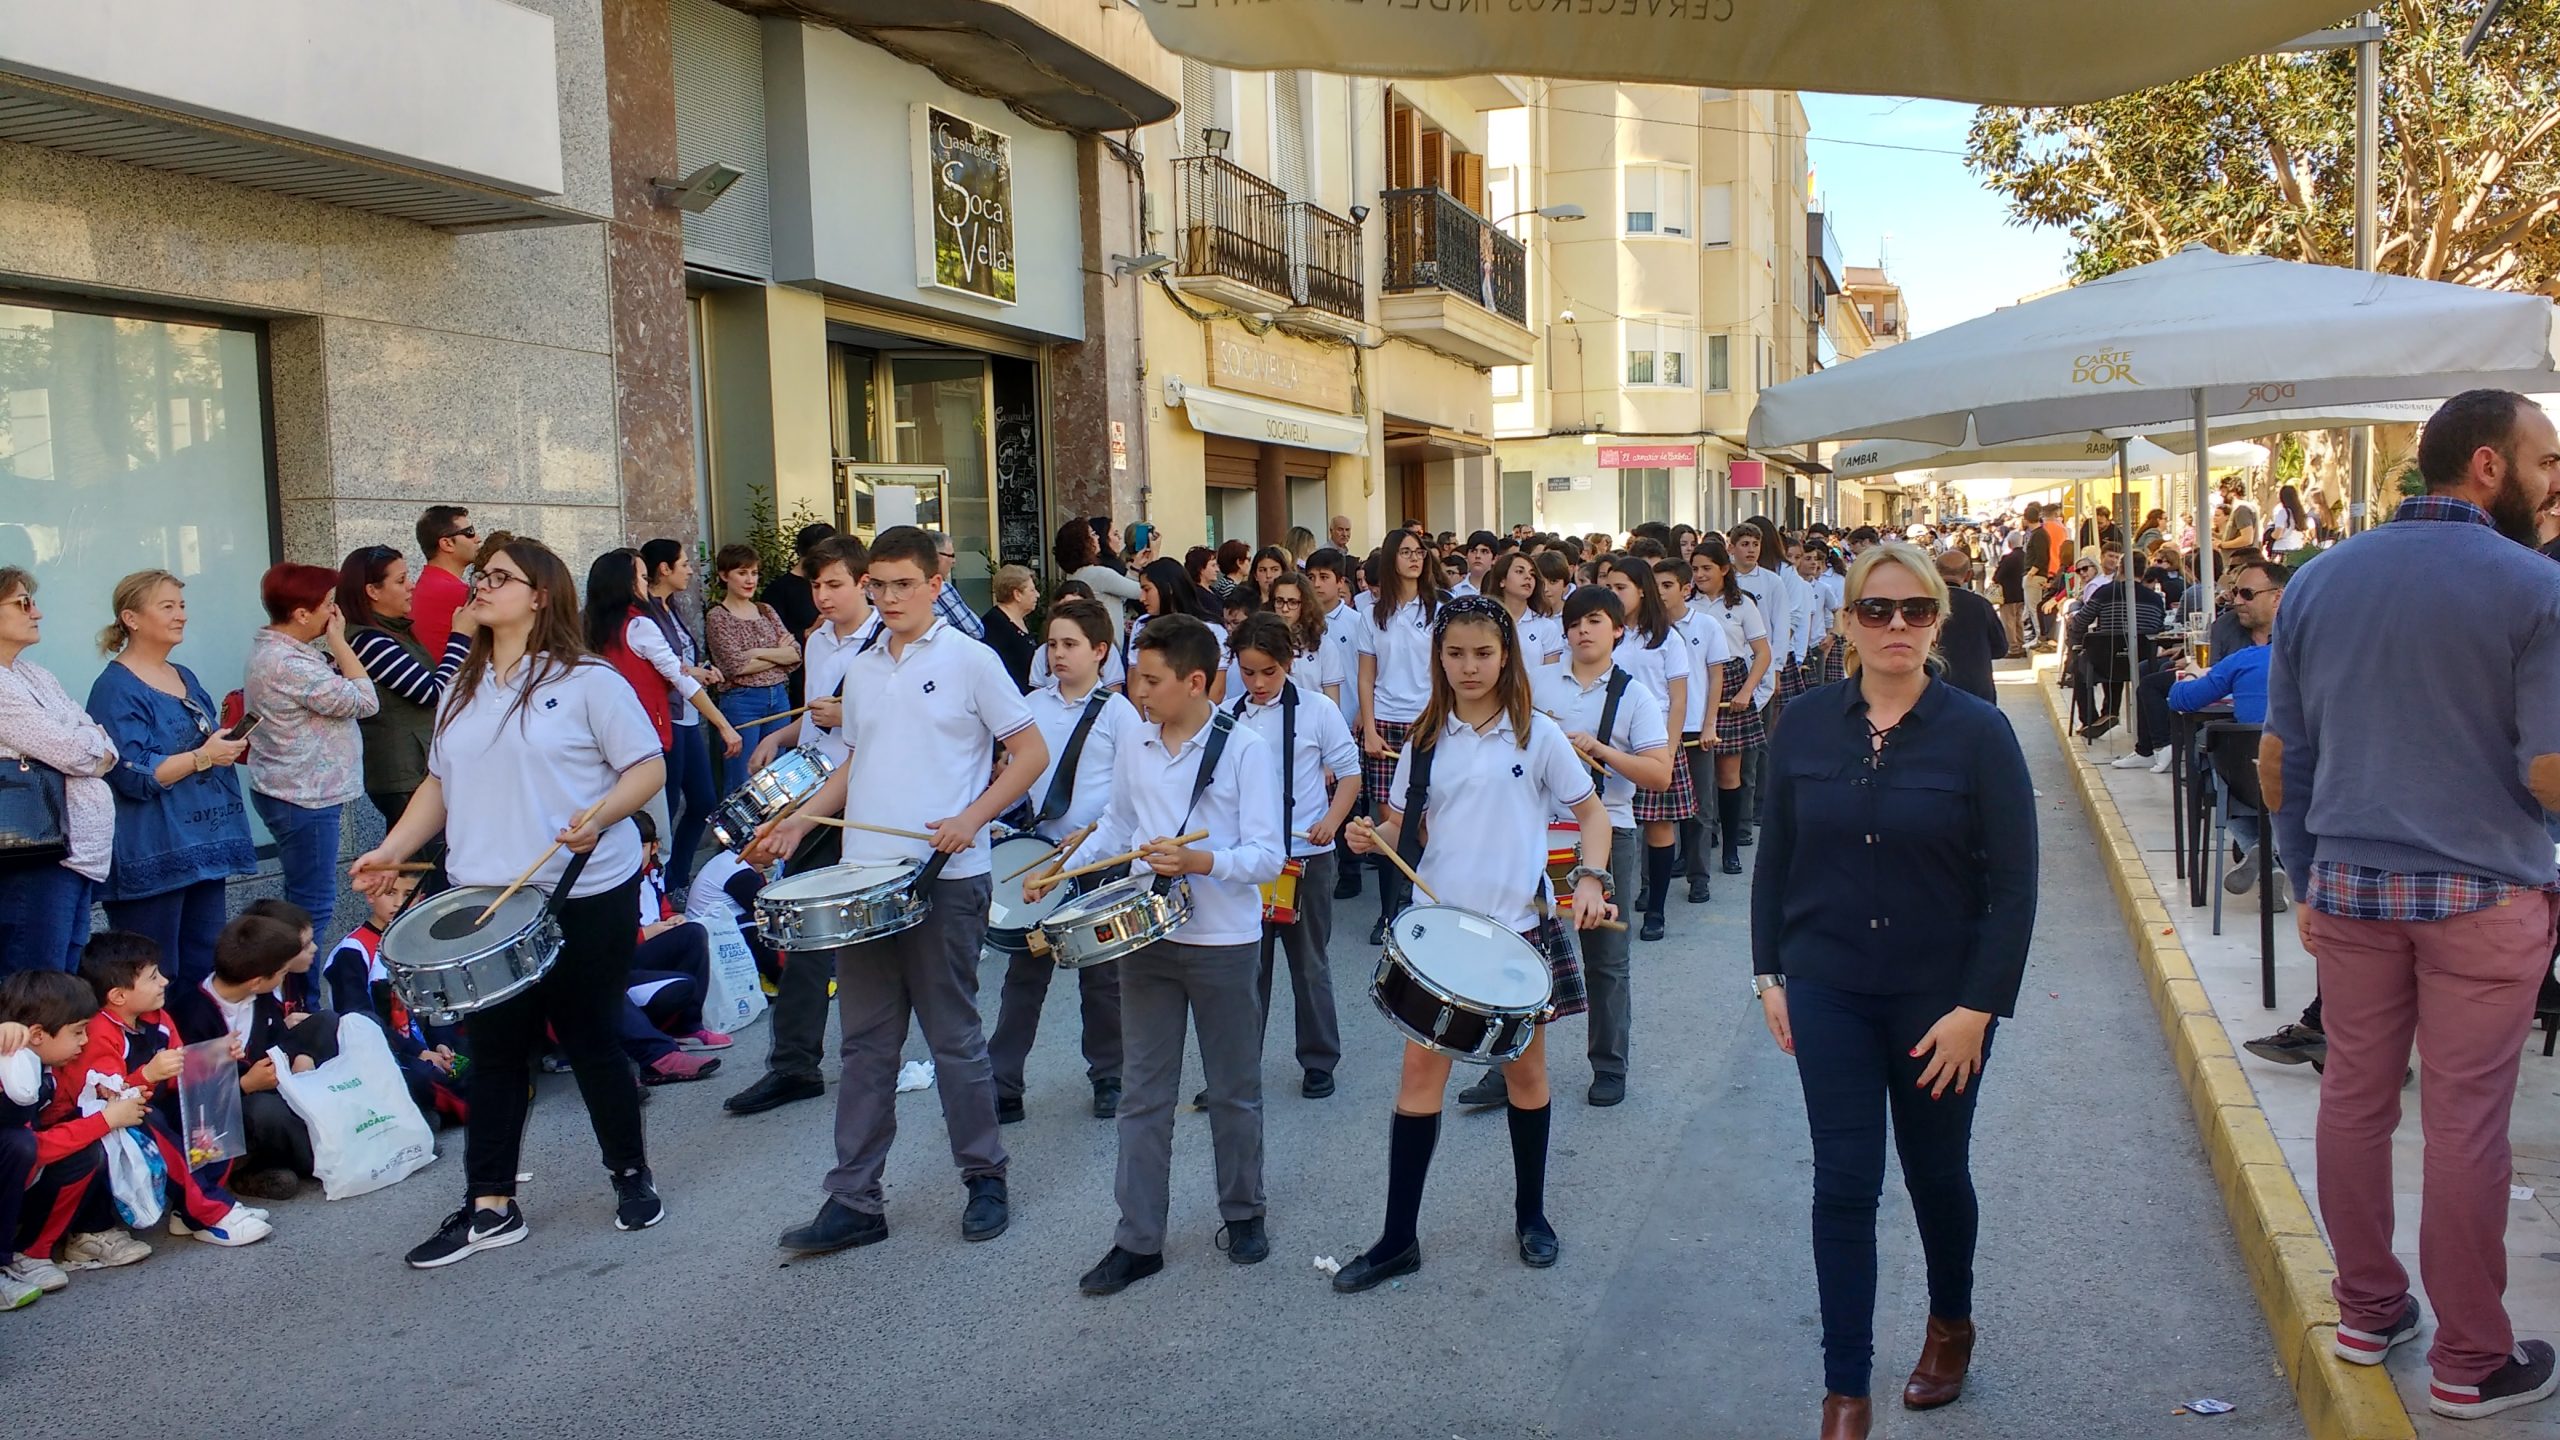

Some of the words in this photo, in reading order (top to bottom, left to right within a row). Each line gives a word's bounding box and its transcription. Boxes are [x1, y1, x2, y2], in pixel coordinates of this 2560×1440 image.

[938, 122, 1002, 166] Gastroteca
[938, 160, 1003, 227] Soca
[953, 215, 1008, 283] Vella
[2073, 350, 2136, 369] CARTE
[2072, 364, 2146, 386] D'OR
[1266, 418, 1310, 443] SOCAVELLA
[1845, 452, 1878, 468] AMBAR
